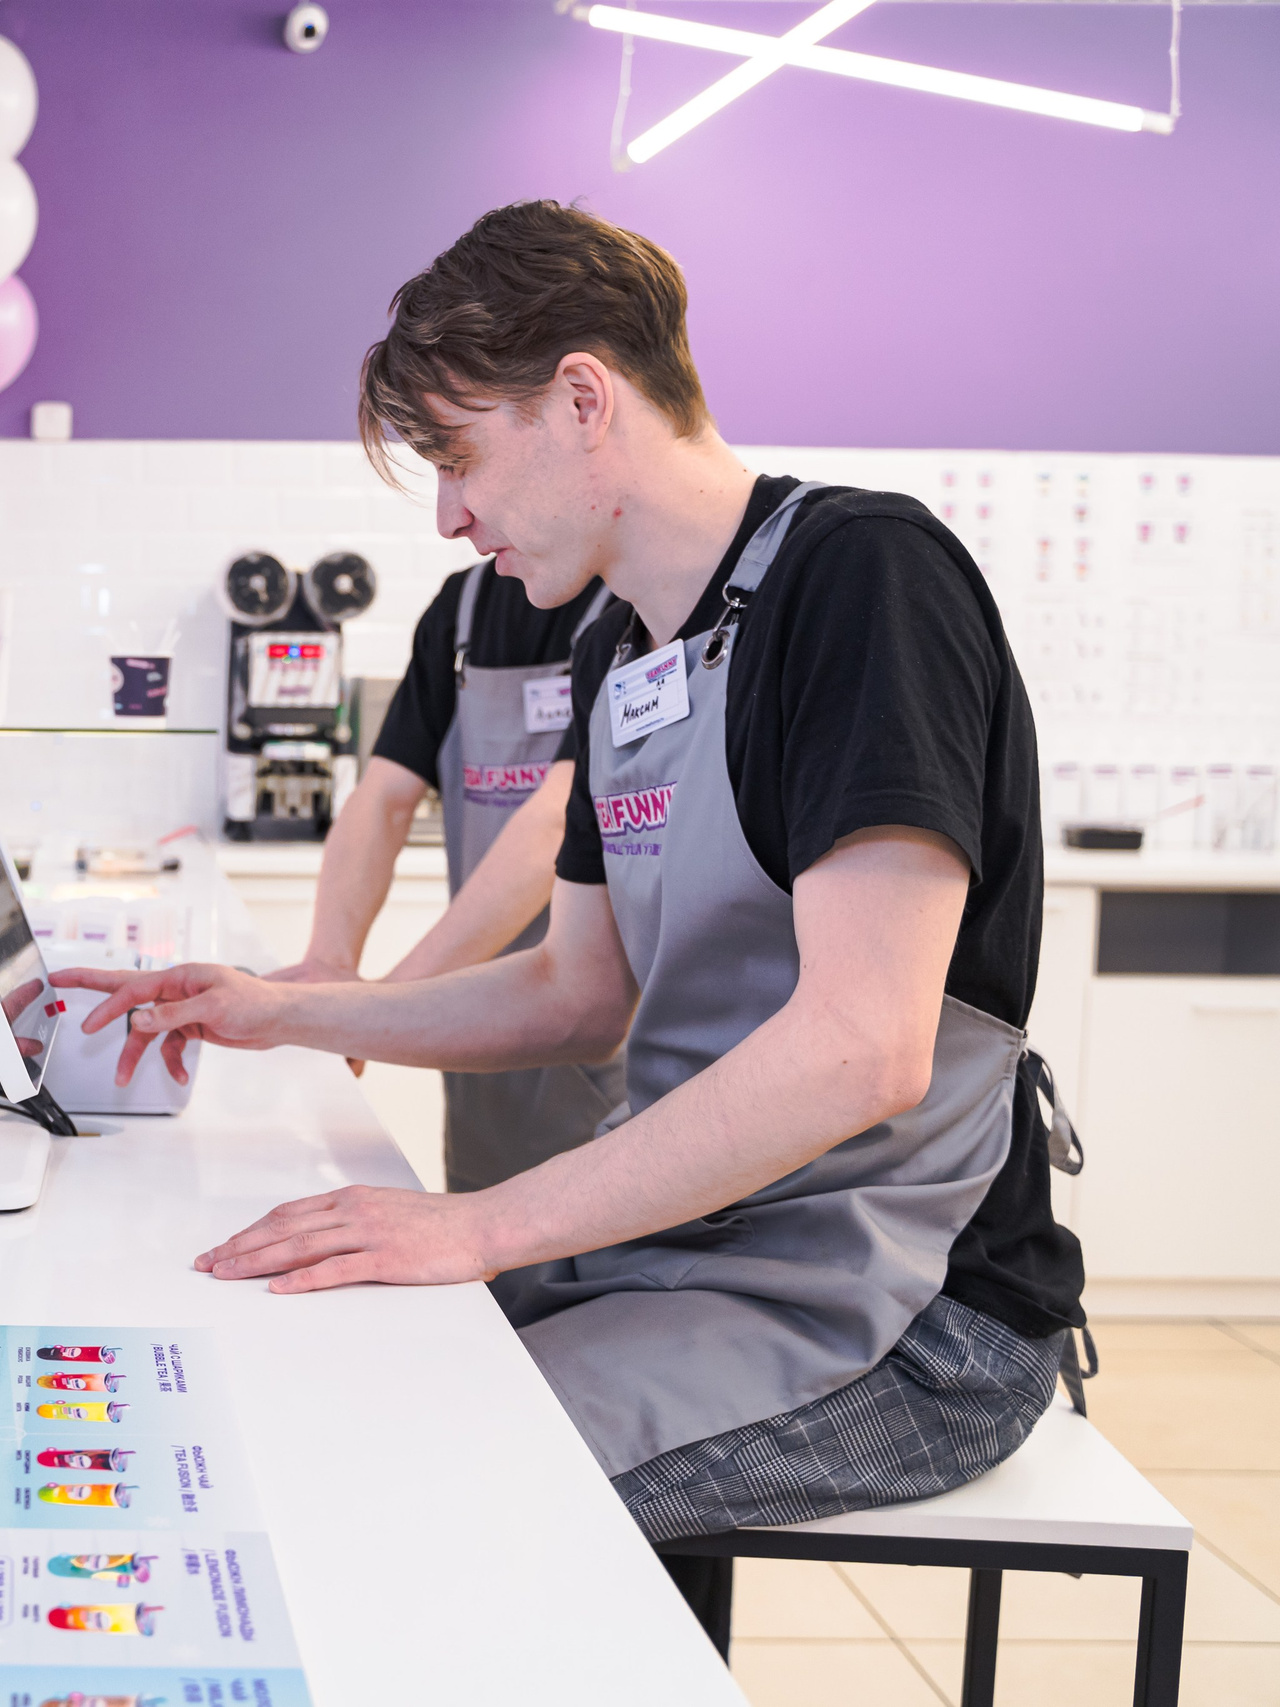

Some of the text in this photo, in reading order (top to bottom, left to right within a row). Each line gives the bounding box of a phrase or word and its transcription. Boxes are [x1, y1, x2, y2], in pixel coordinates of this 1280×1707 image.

[611, 787, 677, 829] FUNN
[153, 1346, 167, 1367] BUBBLE
[169, 1343, 183, 1355] ЧАЙ
[157, 1367, 168, 1379] TEA
[171, 1360, 188, 1393] ШАРИКАМИ
[174, 1449, 187, 1462] TEA
[176, 1463, 191, 1488] FUSION
[198, 1473, 214, 1489] ЧАЙ
